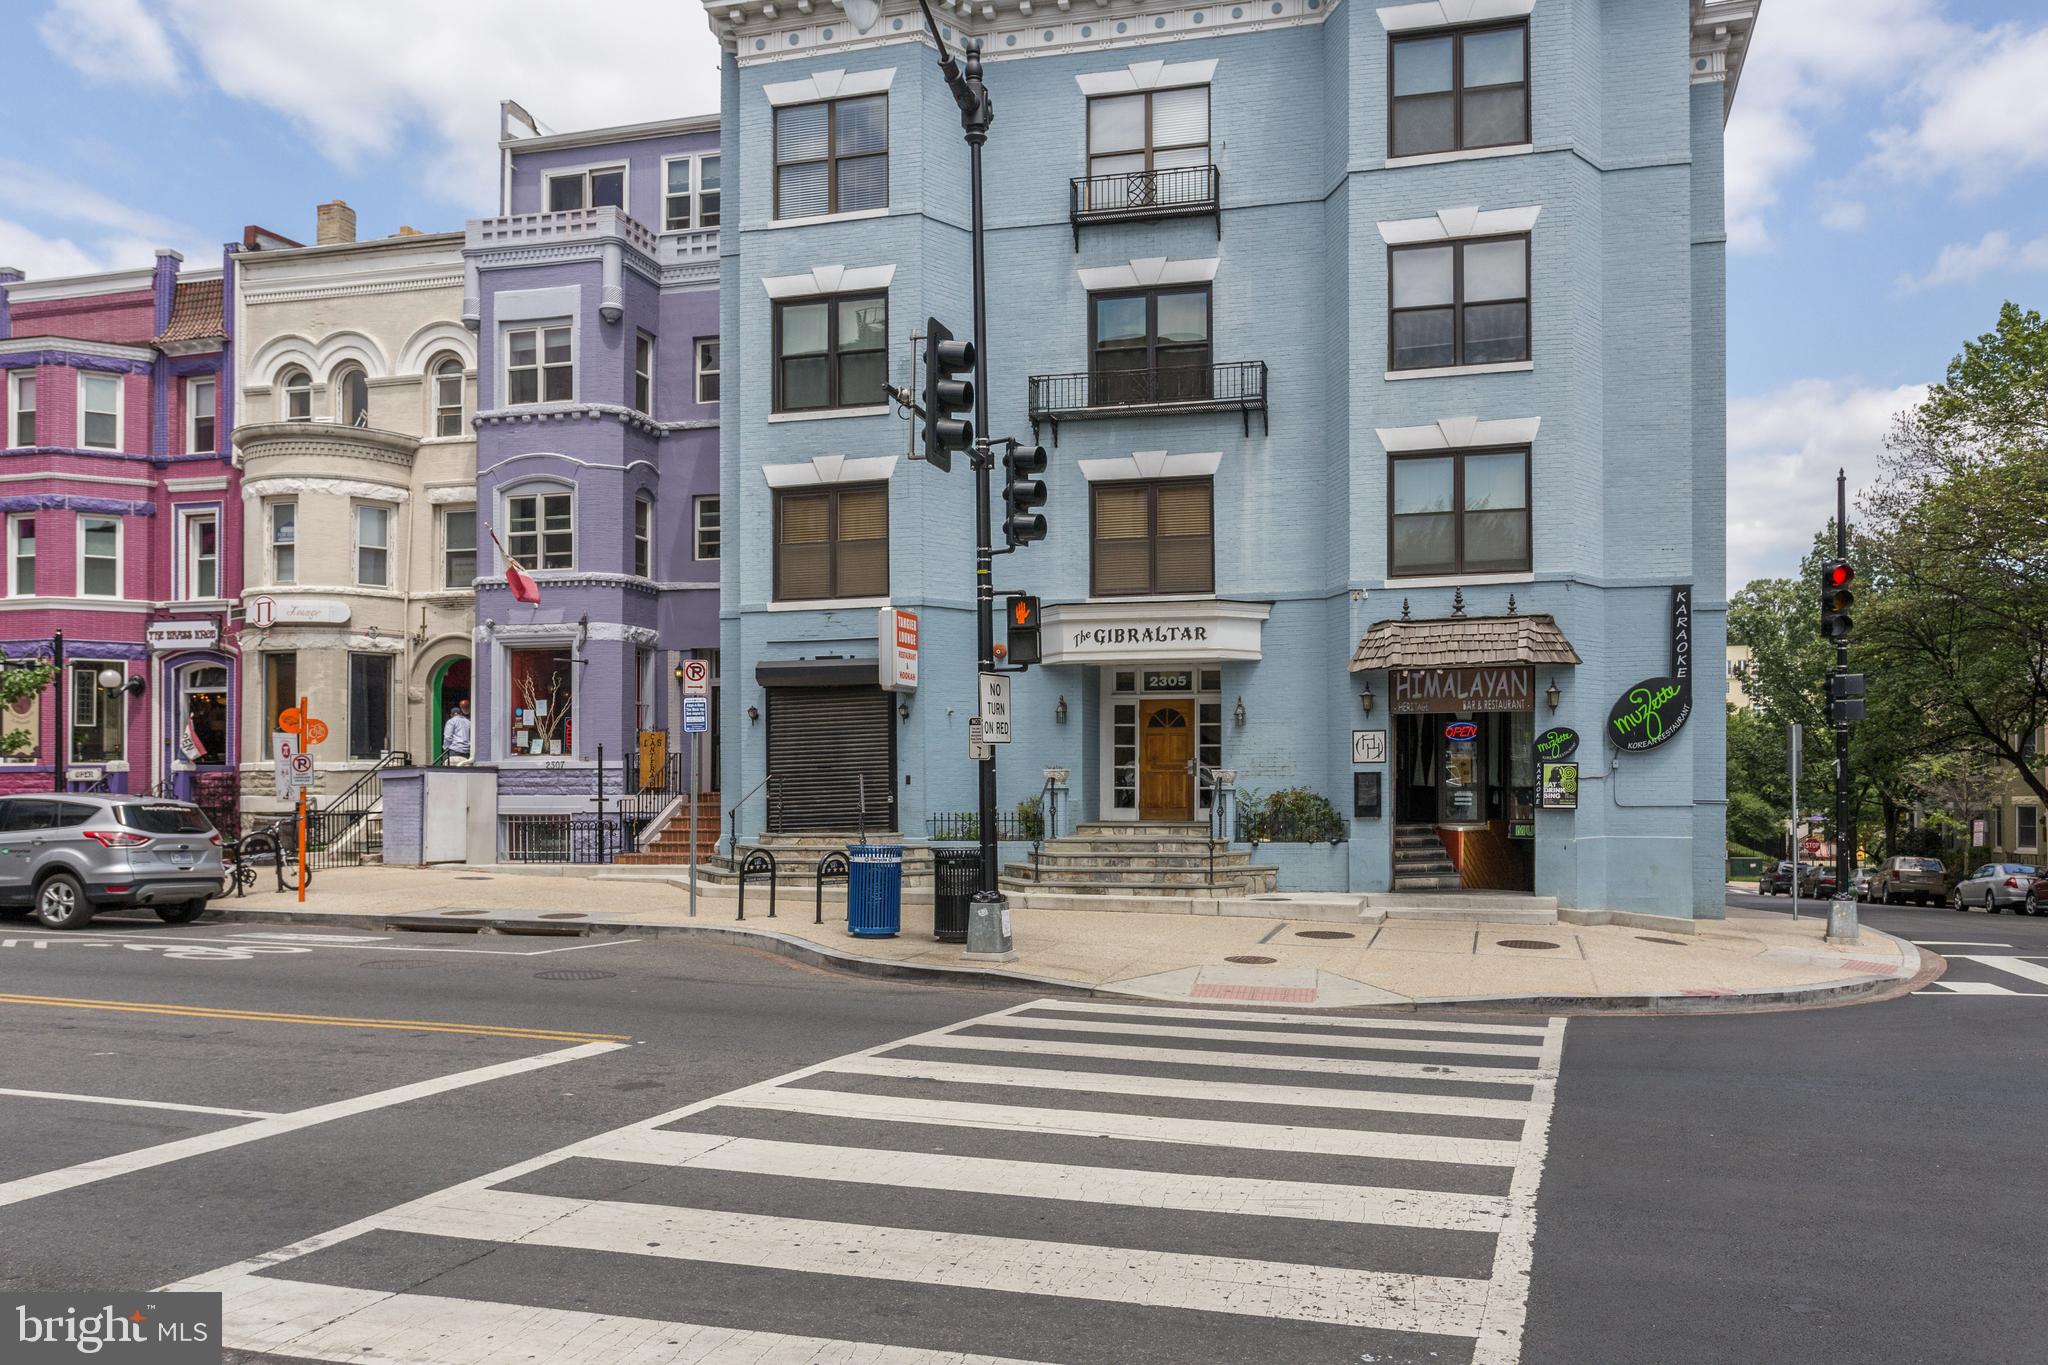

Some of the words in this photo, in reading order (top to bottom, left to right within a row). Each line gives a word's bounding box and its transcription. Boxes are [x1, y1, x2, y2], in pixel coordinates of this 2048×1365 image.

[148, 630, 164, 640] THE
[166, 630, 193, 640] BRASS
[898, 630, 917, 646] LOUNGE
[1073, 629, 1092, 648] The
[1093, 625, 1208, 645] GIBRALTAR
[1676, 591, 1688, 678] KARAOKE
[1149, 675, 1187, 687] 2305
[1396, 669, 1528, 700] HIMALAYAN
[989, 683, 1001, 697] NO
[987, 702, 1005, 716] TURN
[1462, 700, 1476, 711] BAR
[1483, 699, 1525, 710] RESTAURANT
[984, 721, 994, 735] ON
[996, 721, 1009, 735] RED
[1445, 724, 1478, 738] OPEN
[1627, 736, 1657, 750] KOREAN
[1657, 703, 1690, 742] RESTAURANT
[545, 761, 565, 769] 2307
[1804, 841, 1820, 849] STOP
